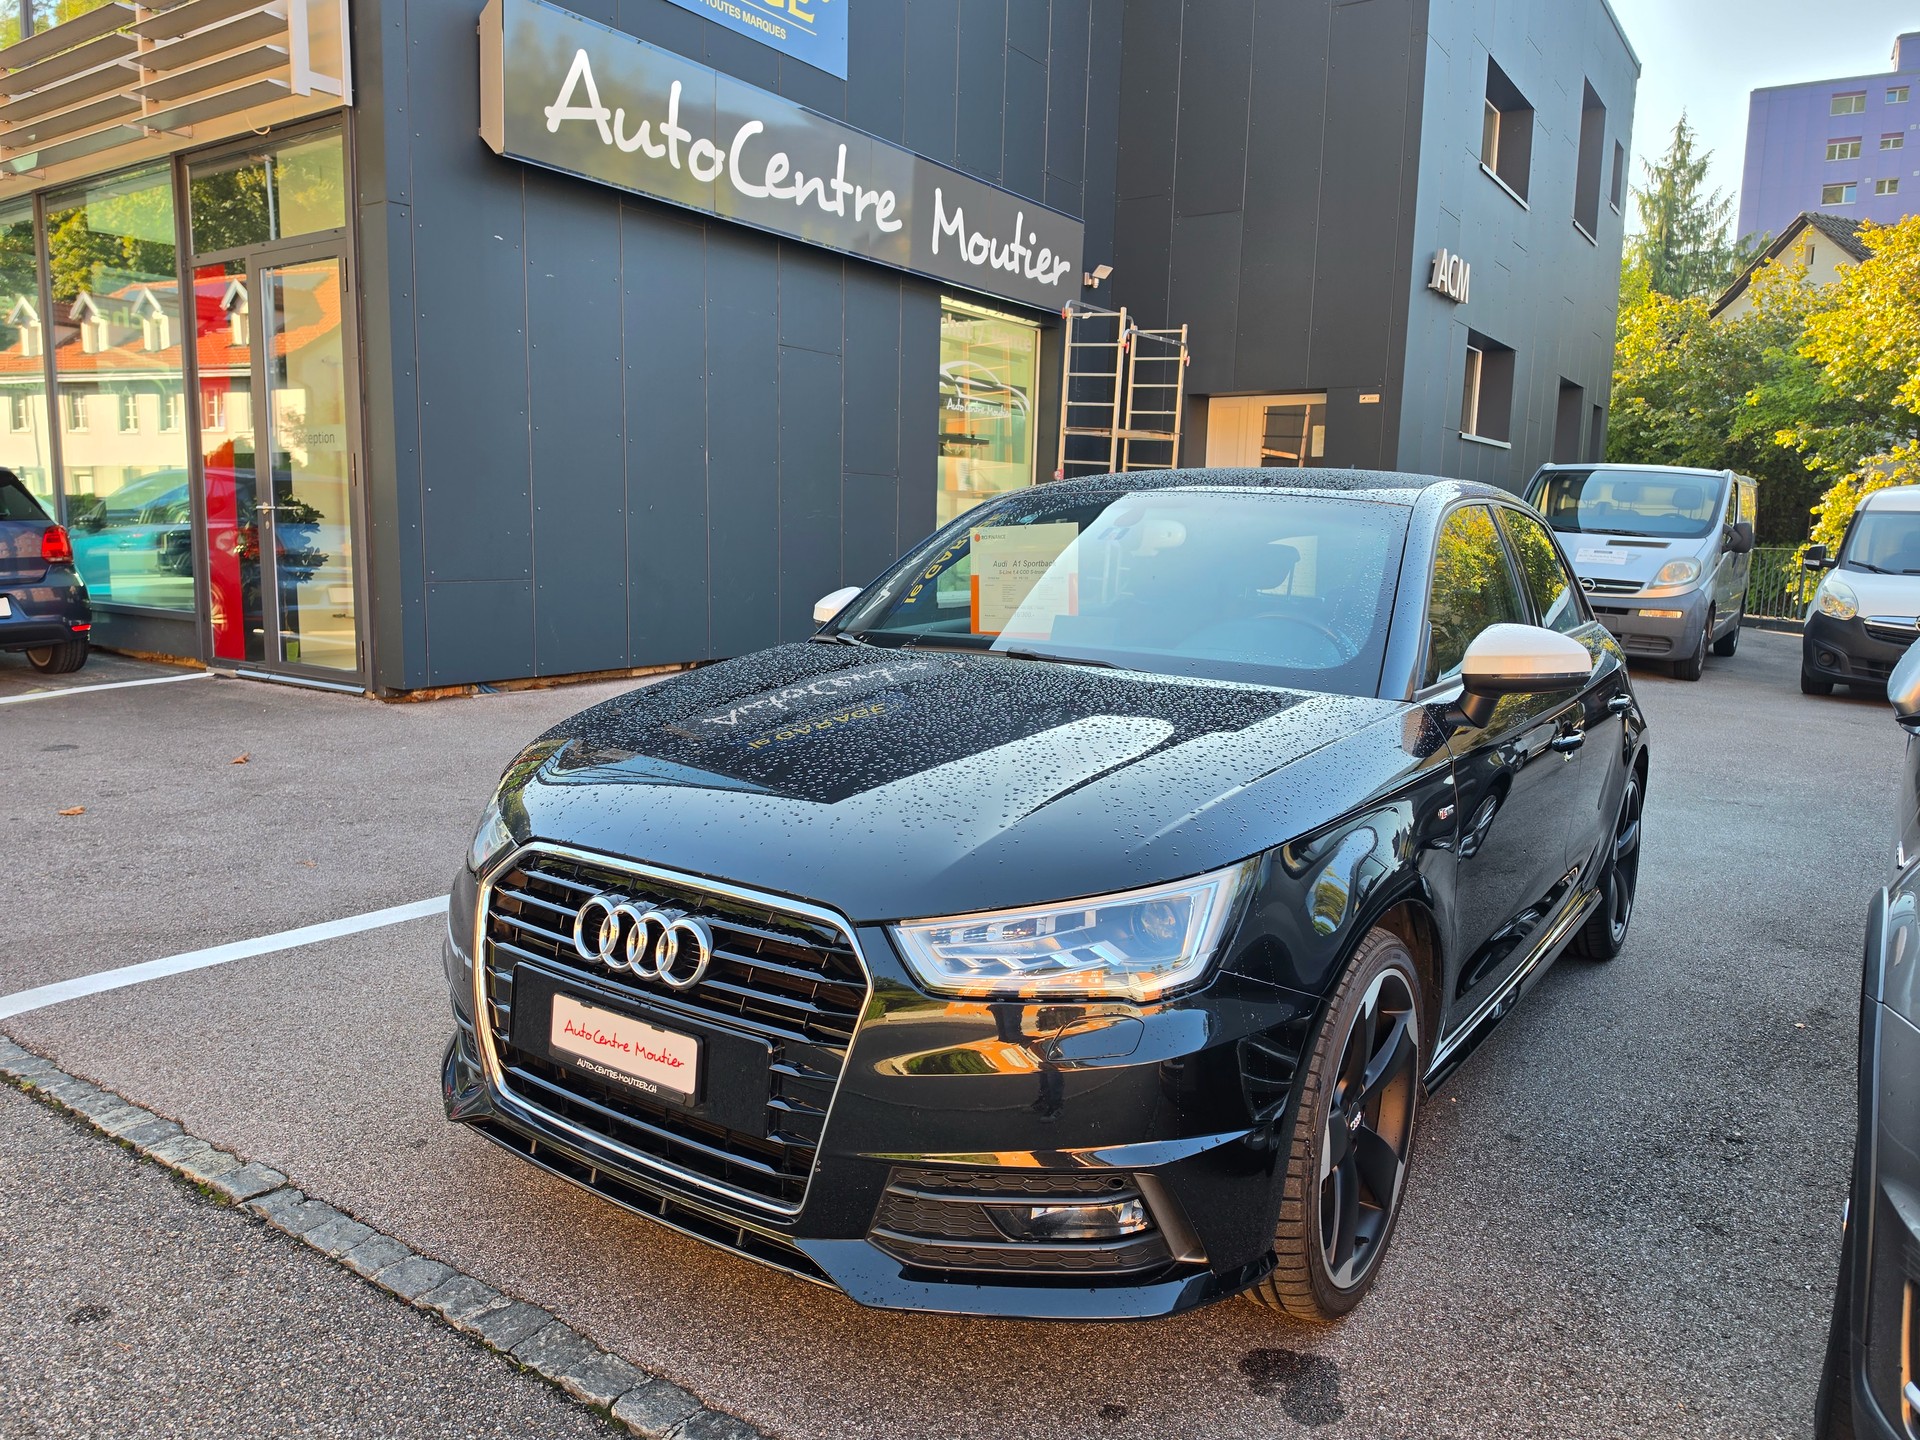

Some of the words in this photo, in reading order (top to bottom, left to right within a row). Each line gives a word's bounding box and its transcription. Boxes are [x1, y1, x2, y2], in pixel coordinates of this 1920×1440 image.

[742, 11, 787, 40] MARQUES
[545, 49, 902, 232] AutoCentre
[932, 188, 1070, 286] Moutier
[1432, 248, 1470, 304] ACM
[993, 560, 1008, 568] Audi
[1012, 560, 1021, 568] A1
[564, 1019, 630, 1053] AutoCentre
[635, 1042, 685, 1068] Moutier
